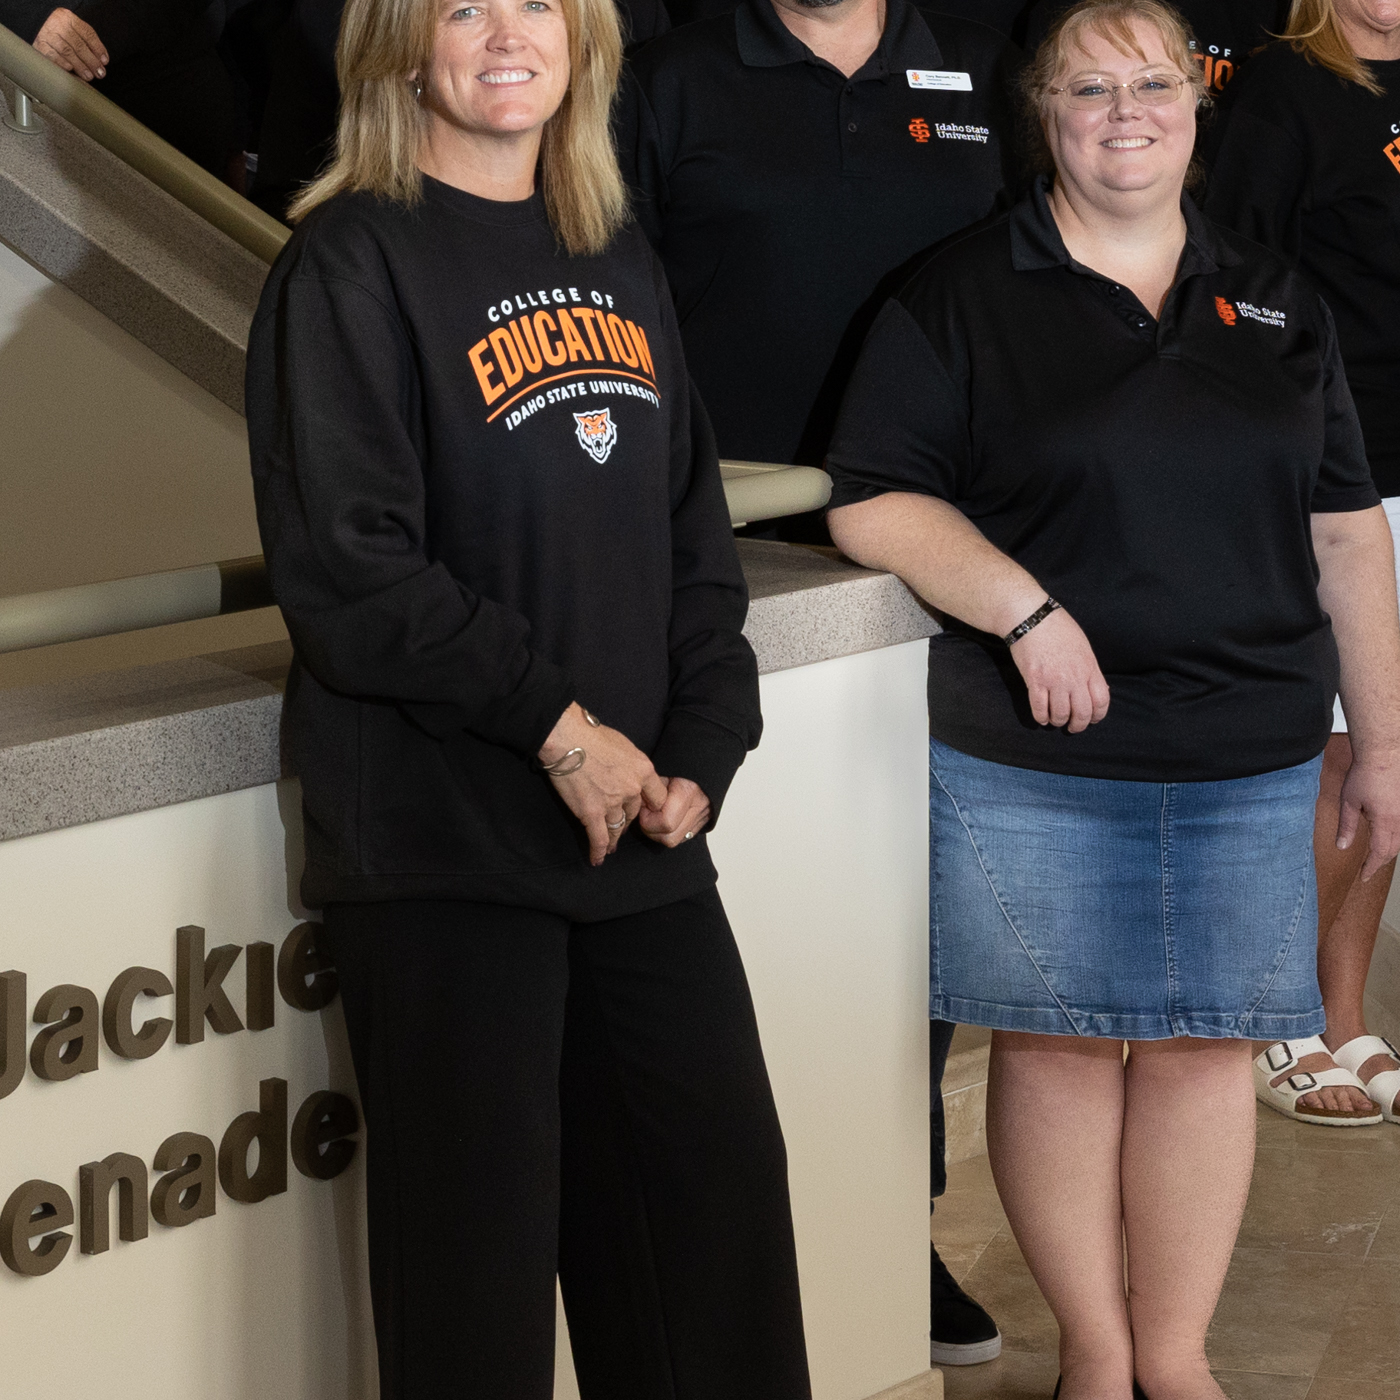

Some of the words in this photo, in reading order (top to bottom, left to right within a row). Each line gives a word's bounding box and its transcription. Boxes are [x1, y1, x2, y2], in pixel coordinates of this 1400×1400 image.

[1209, 44, 1231, 57] OF
[934, 123, 964, 132] Idaho
[965, 125, 990, 135] State
[937, 131, 988, 144] University
[488, 287, 582, 322] COLLEGE
[590, 290, 614, 309] OF
[1235, 301, 1261, 315] Idaho
[1261, 307, 1286, 319] State
[468, 307, 656, 406] EDUCATION
[505, 395, 546, 431] IDAHO
[546, 381, 588, 404] STATE
[589, 380, 660, 409] UNIVERSITY
